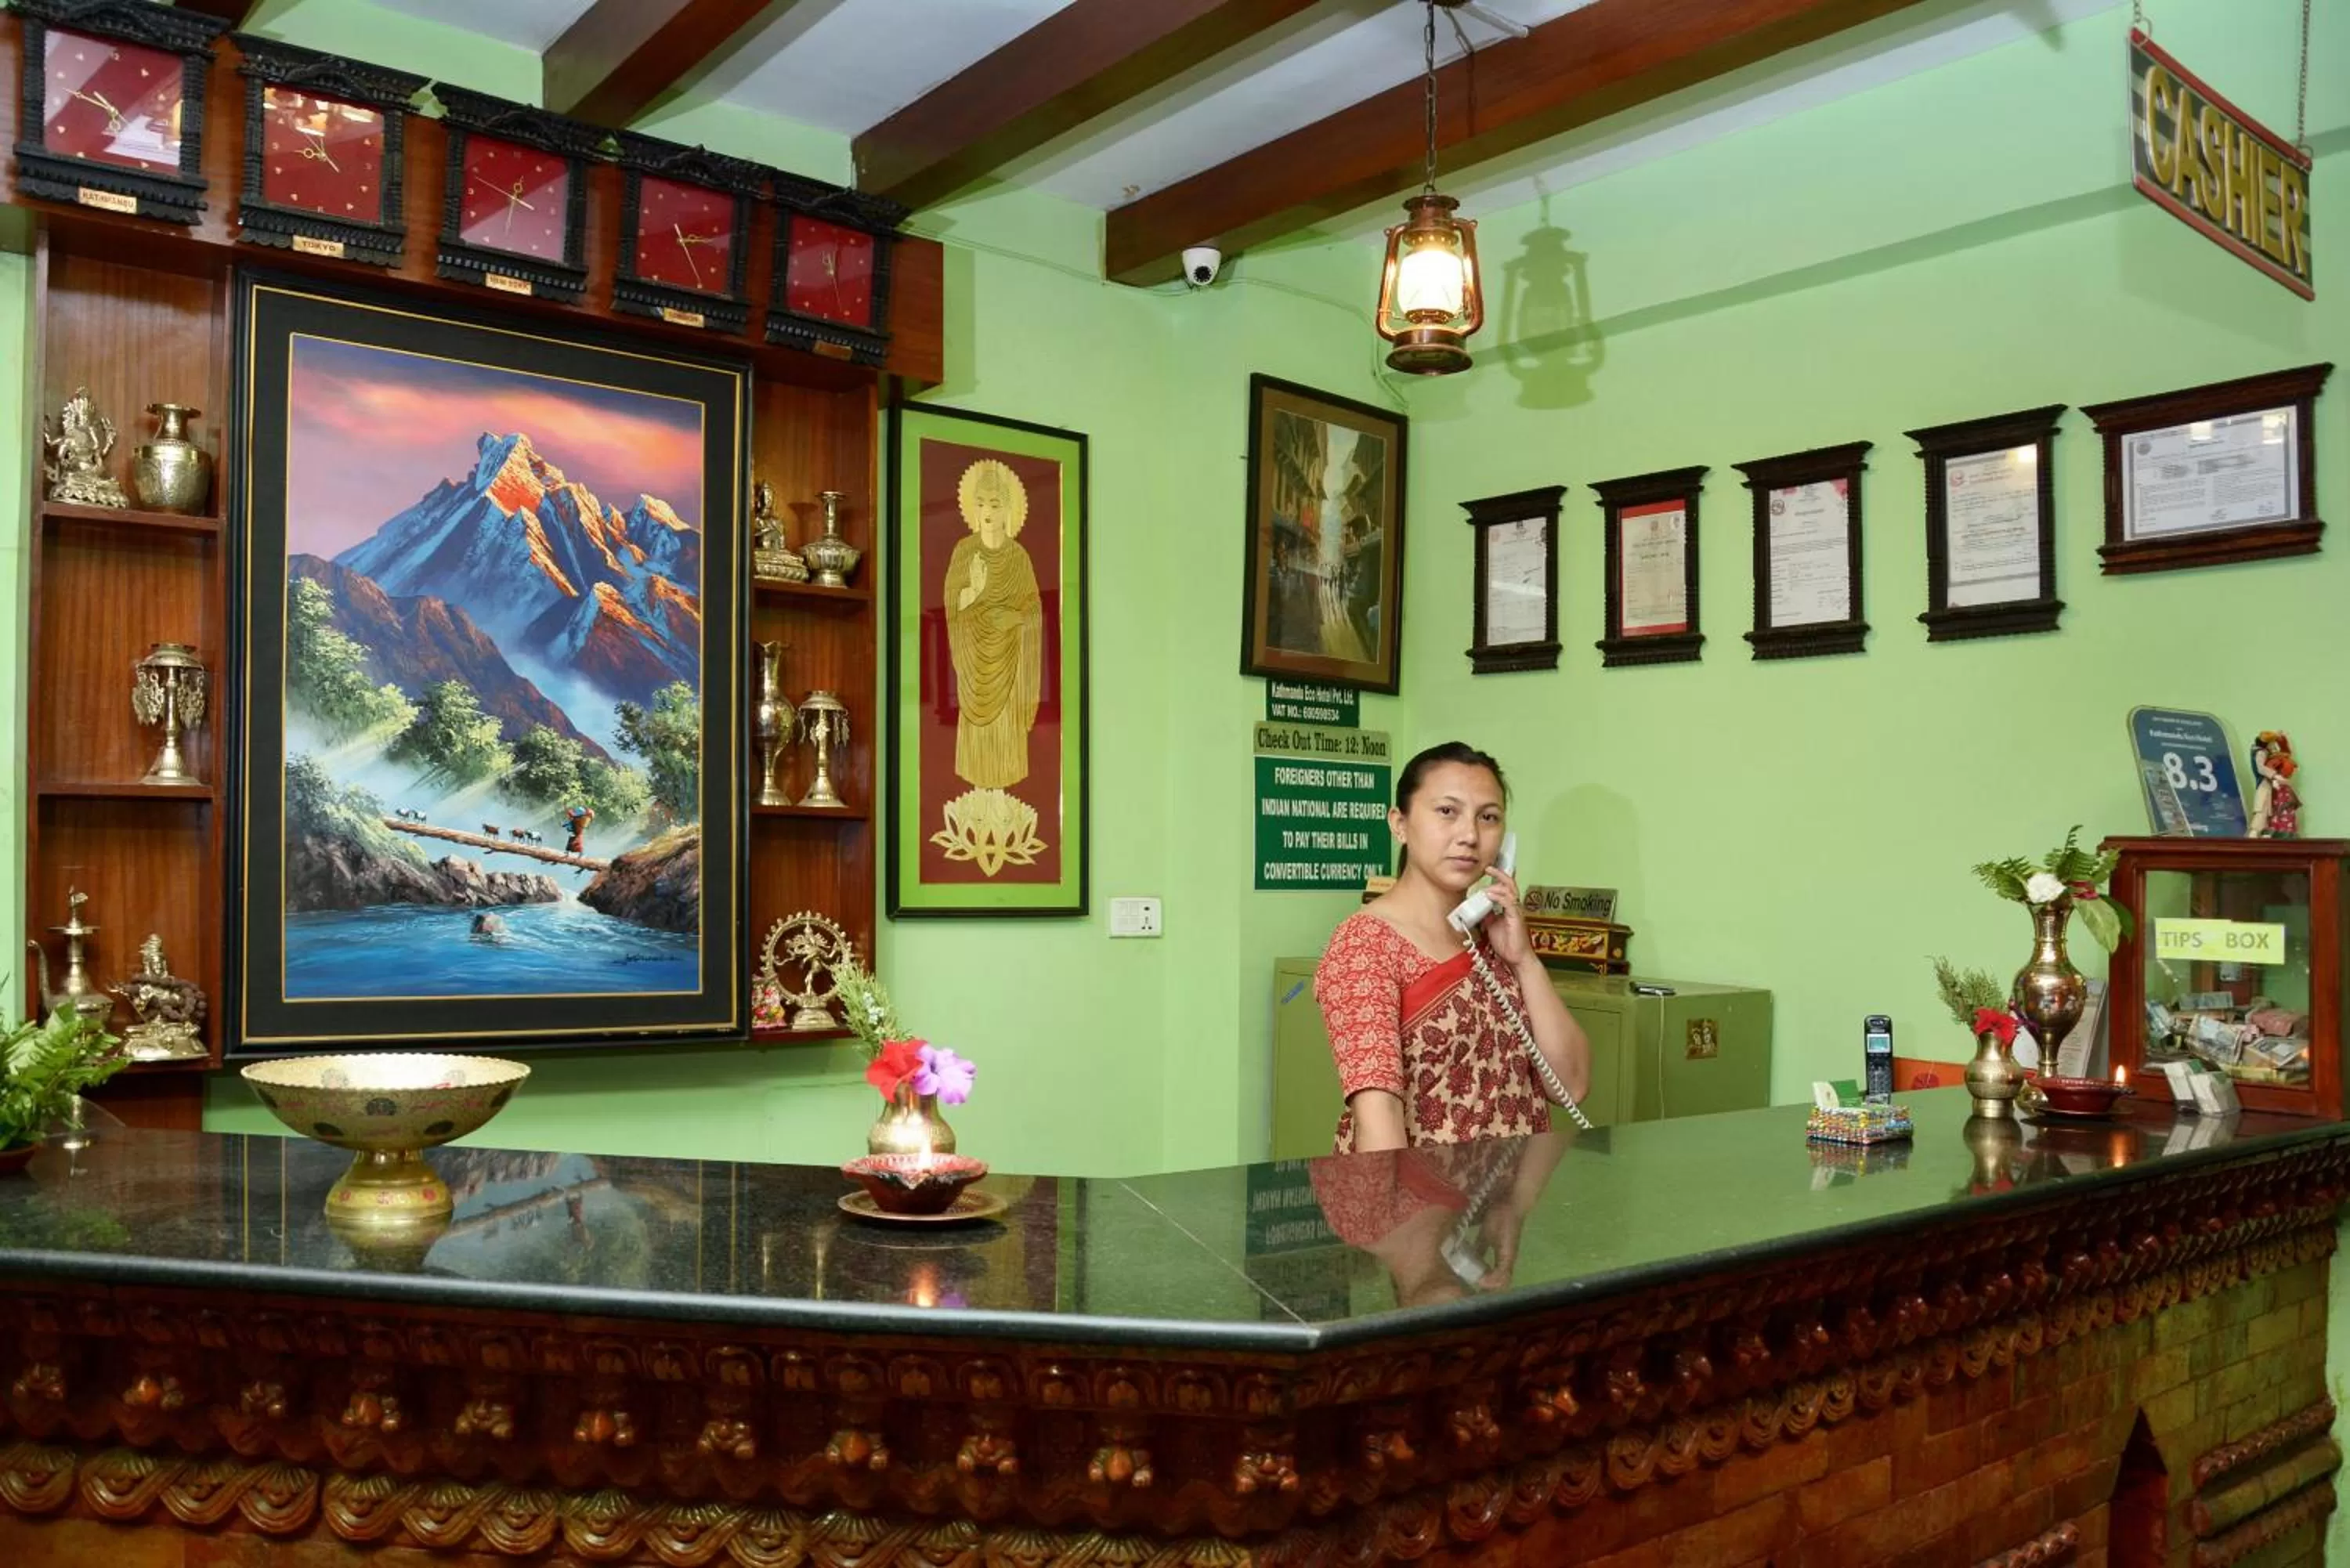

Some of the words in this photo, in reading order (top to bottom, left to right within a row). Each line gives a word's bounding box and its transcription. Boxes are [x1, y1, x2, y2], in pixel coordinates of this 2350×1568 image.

[2144, 65, 2306, 276] CASHIER
[1271, 703, 1285, 717] VAT
[1257, 728, 1290, 749] Check
[1292, 729, 1311, 750] Out
[1314, 732, 1342, 753] Time:
[1361, 735, 1386, 757] Noon
[1274, 767, 1325, 786] FOREIGNERS
[1326, 769, 1353, 789] OTHER
[1354, 771, 1375, 789] THAN
[2163, 752, 2218, 792] 8.3
[1261, 797, 1290, 816] INDIAN
[1292, 799, 1330, 818] NATIONAL
[1332, 801, 1347, 818] ARE
[1348, 801, 1386, 820] REQUIRED
[1282, 831, 1292, 848] TO
[1295, 831, 1311, 848] PAY
[1311, 832, 1335, 849] THEIR
[1336, 832, 1358, 850] BILLS
[1359, 833, 1368, 850] IN
[1264, 862, 1319, 880] CONVERTIBLE
[1321, 863, 1361, 880] CURRENCY
[1544, 891, 1560, 909] No
[1562, 891, 1611, 916] Smoking
[2160, 930, 2204, 948] TIPS
[2225, 931, 2269, 949] BOX
